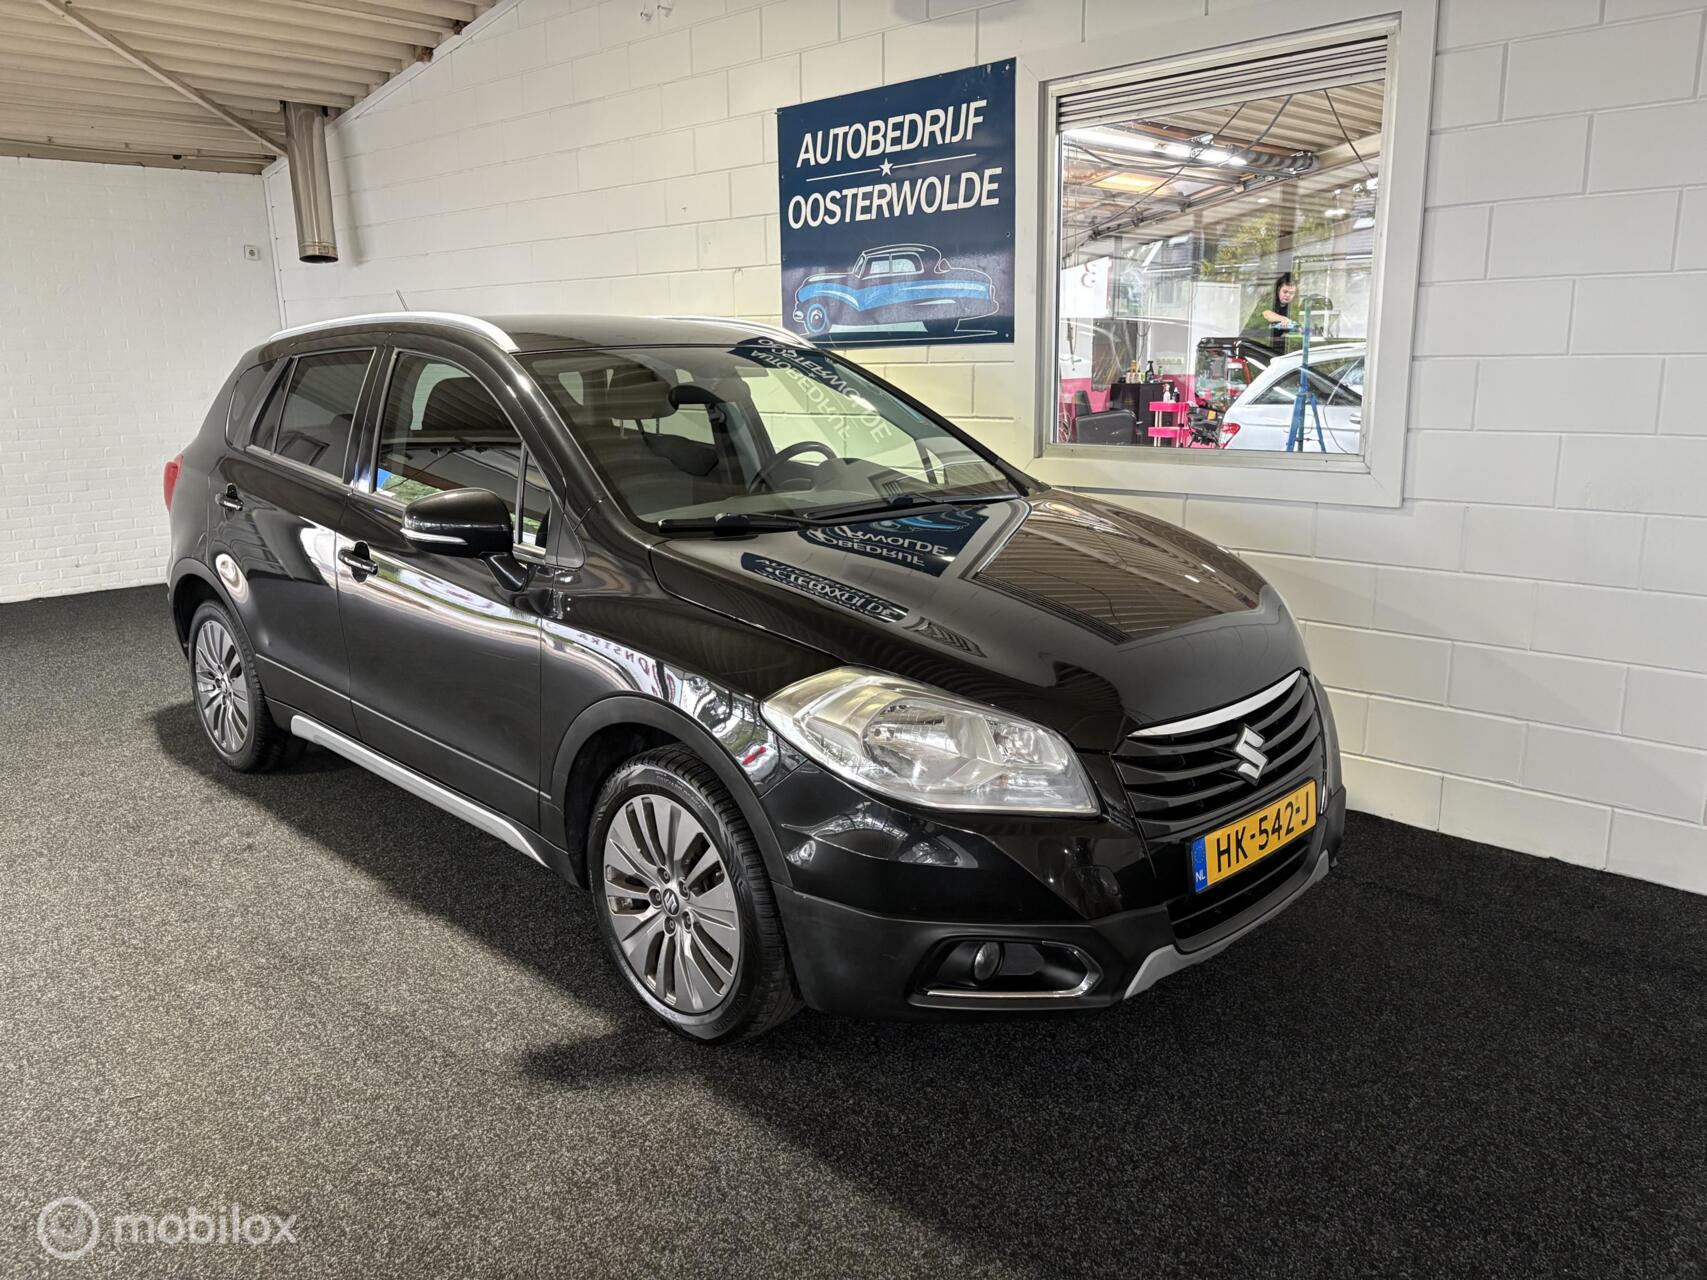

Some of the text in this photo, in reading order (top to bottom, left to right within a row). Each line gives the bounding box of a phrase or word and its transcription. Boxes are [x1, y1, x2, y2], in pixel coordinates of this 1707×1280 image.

[796, 99, 987, 168] AUTOBEDRIJF
[788, 167, 1002, 229] OOSTERWOLDE
[1216, 791, 1309, 873] HK-542-J
[1195, 870, 1206, 882] NL
